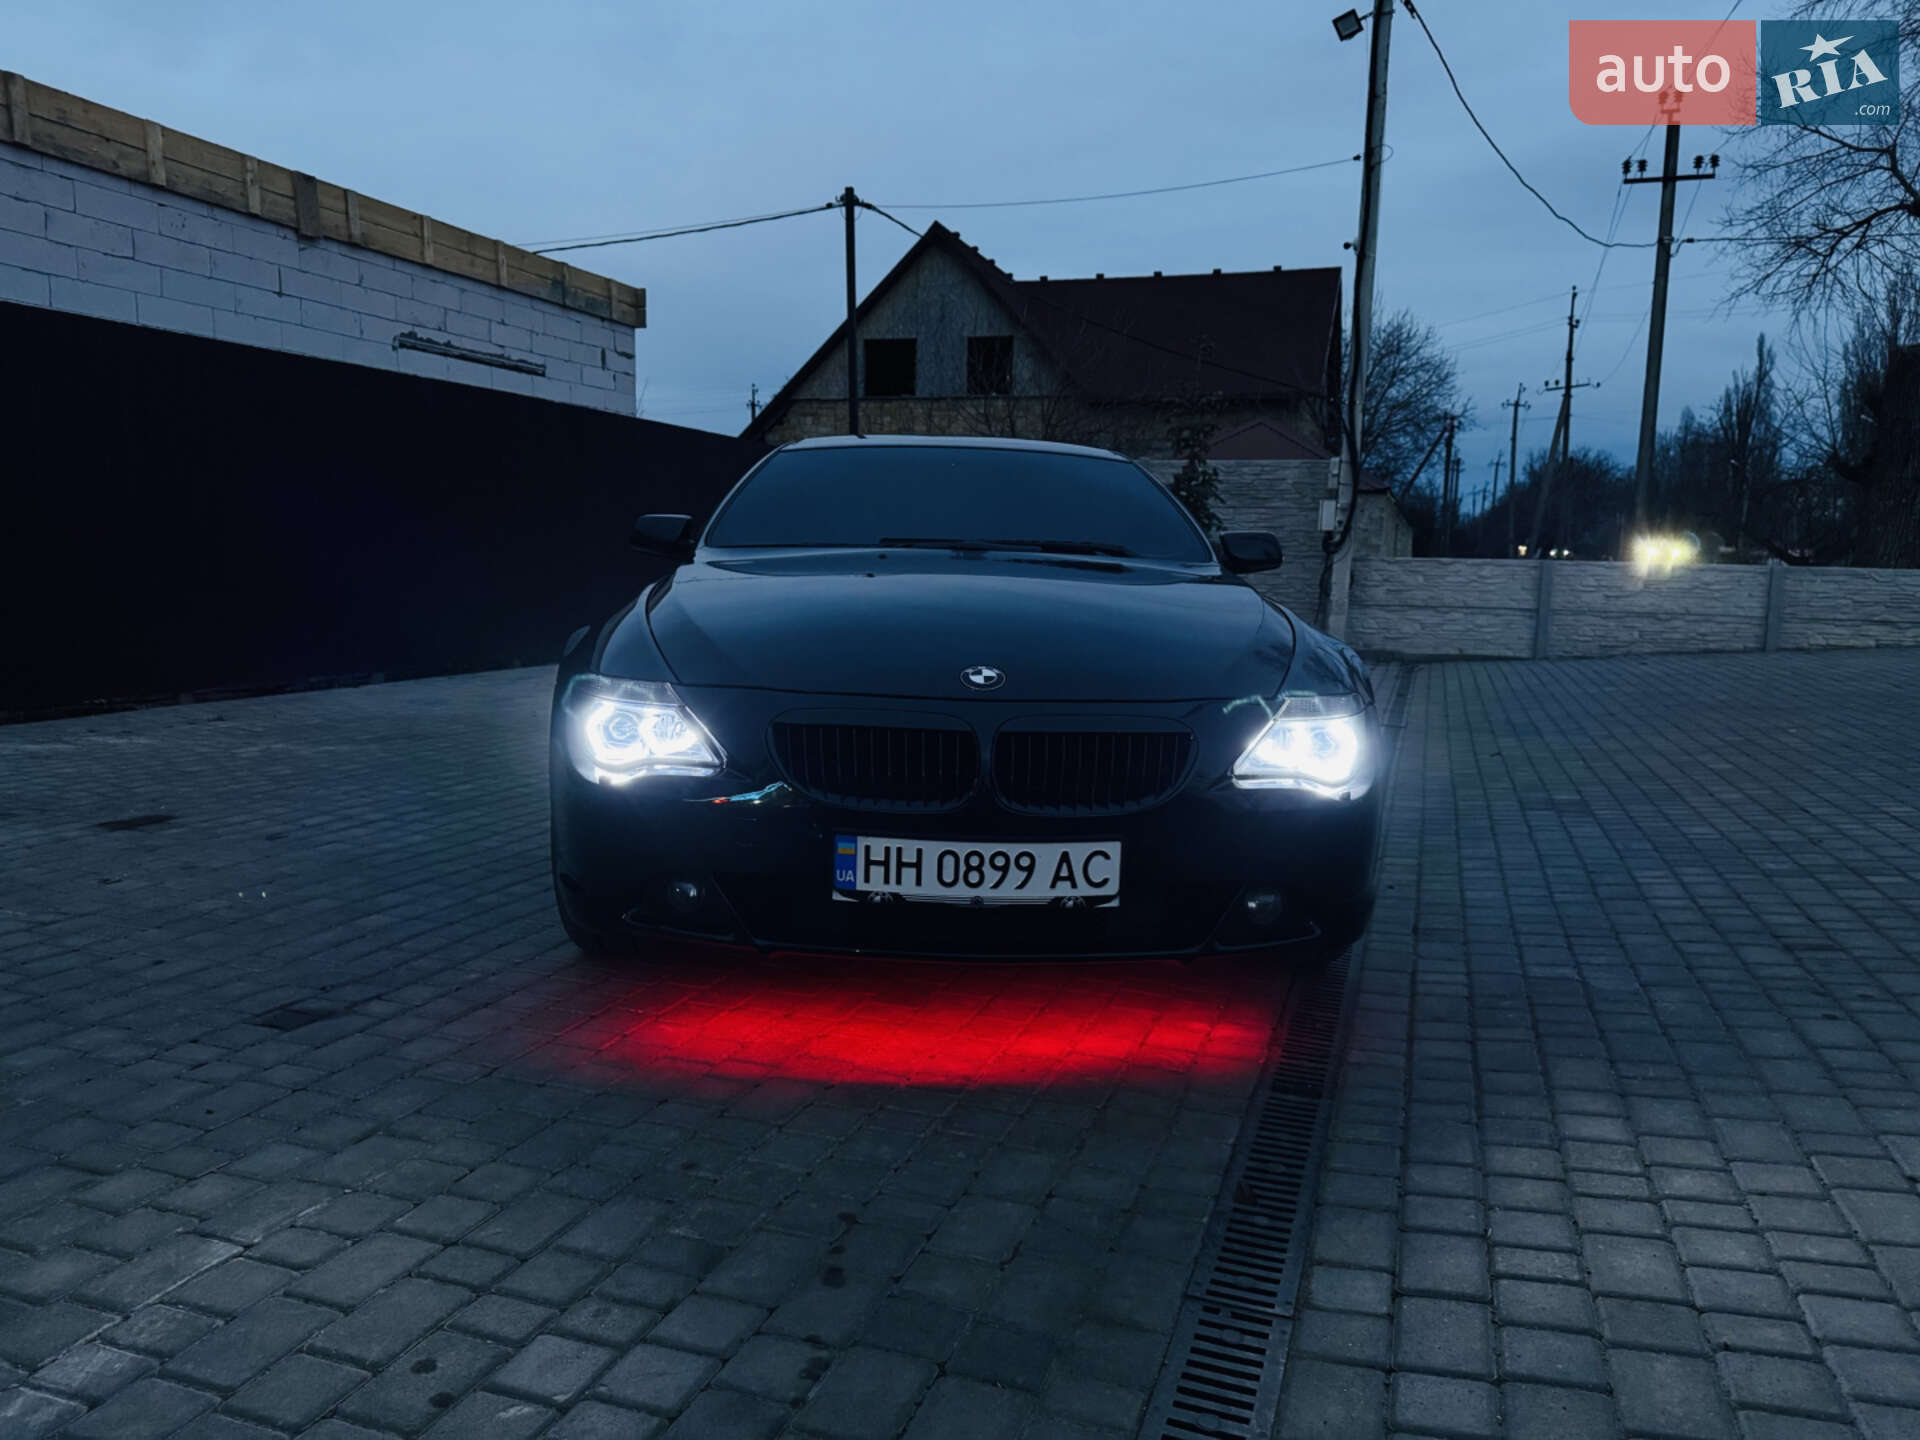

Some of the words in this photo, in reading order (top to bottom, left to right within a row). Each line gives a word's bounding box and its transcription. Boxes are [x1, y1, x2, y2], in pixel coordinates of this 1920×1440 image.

[836, 869, 855, 883] UA
[863, 844, 923, 887] HH
[936, 849, 1036, 889] 0899
[1049, 849, 1111, 889] AC
